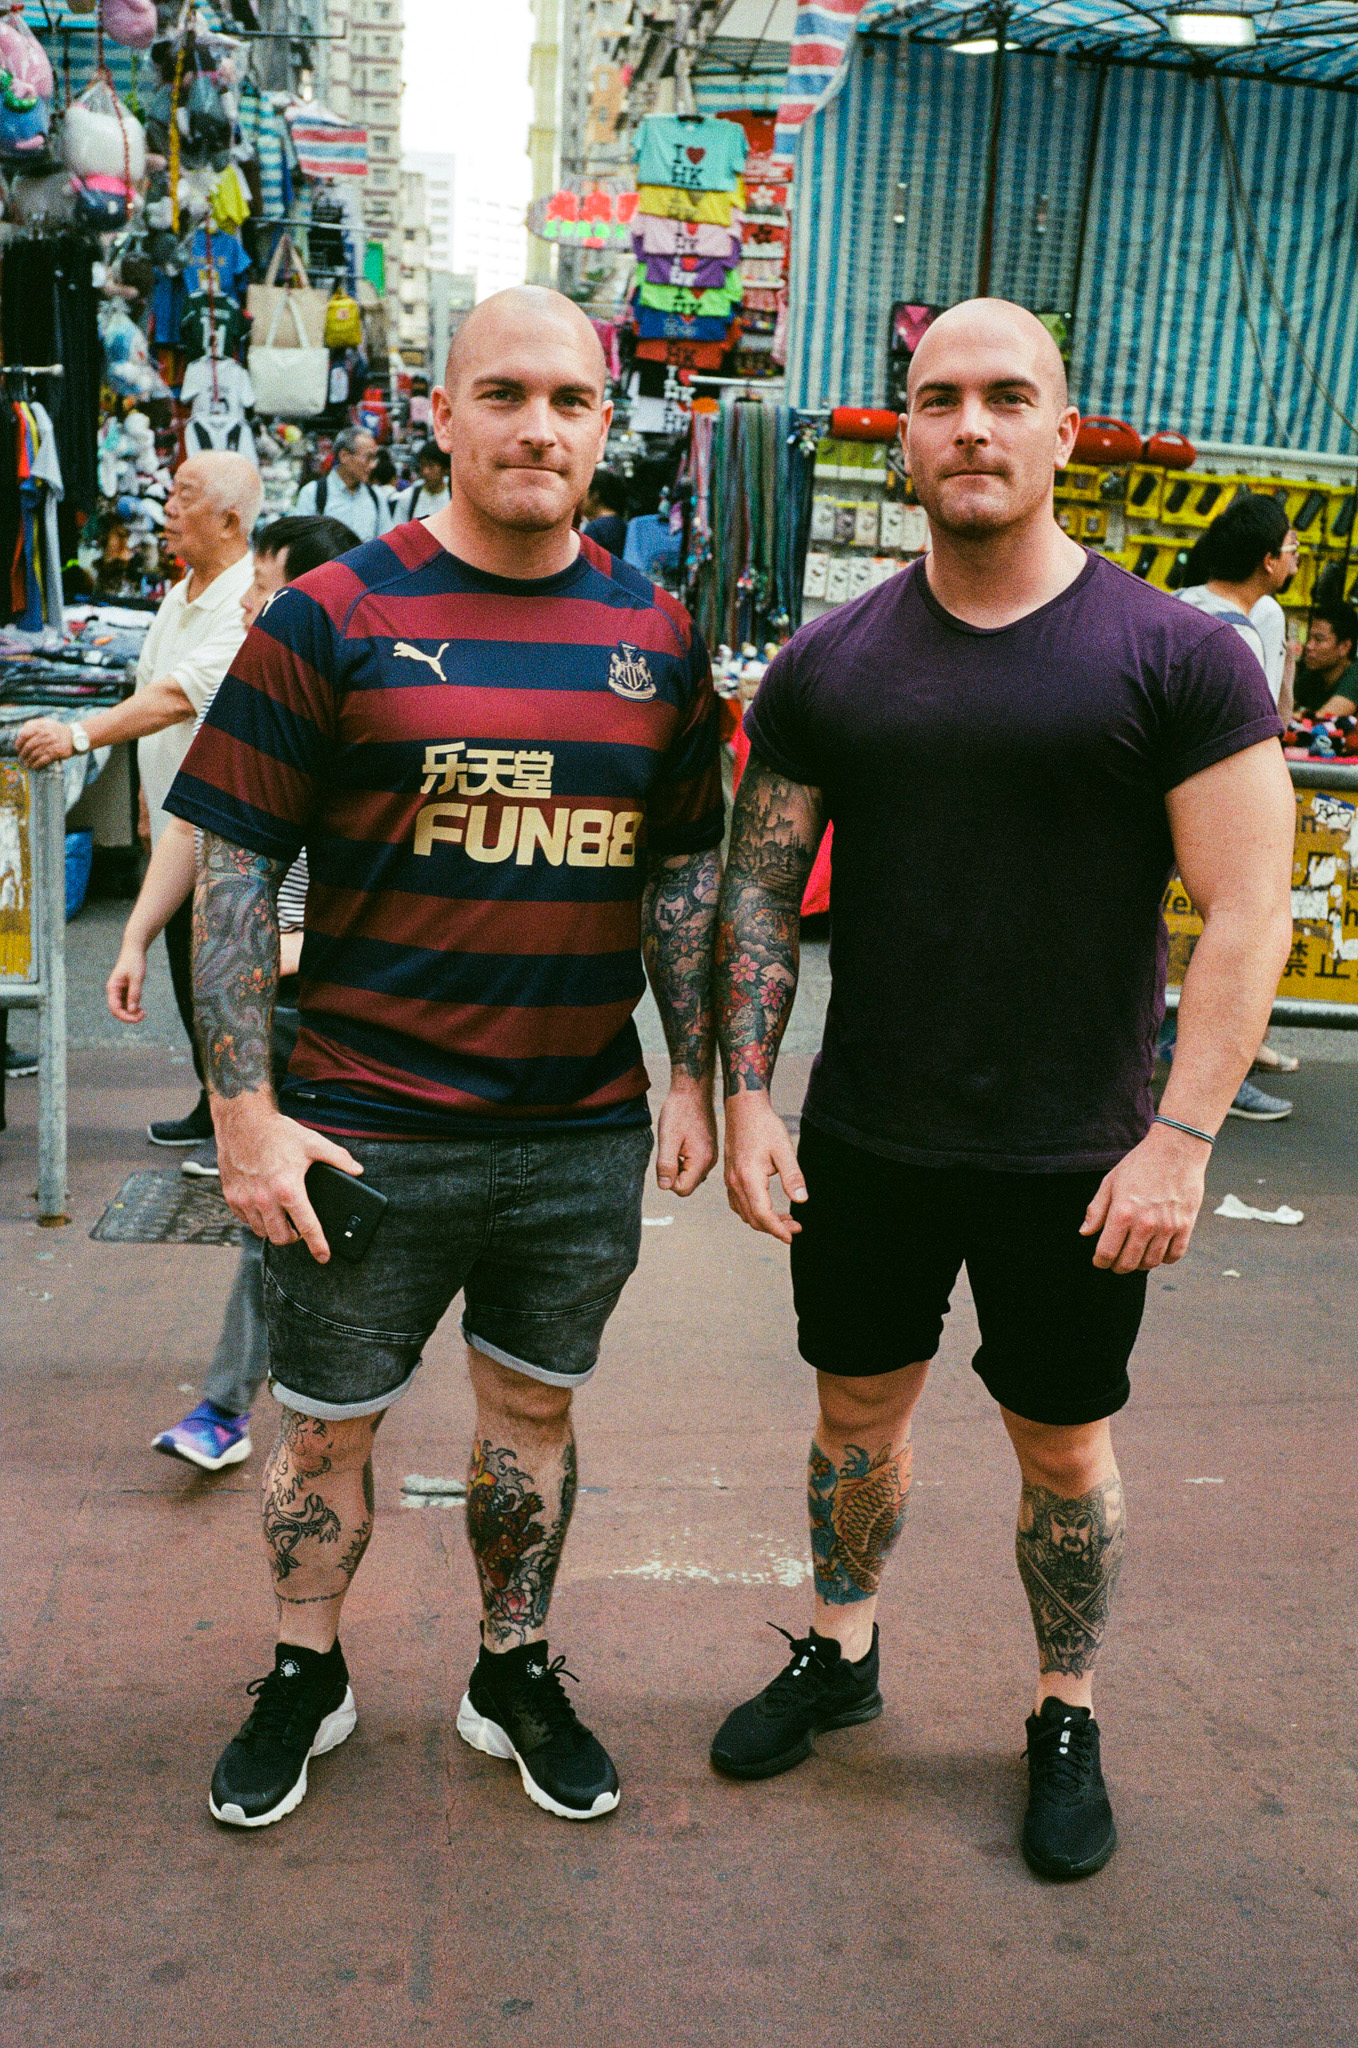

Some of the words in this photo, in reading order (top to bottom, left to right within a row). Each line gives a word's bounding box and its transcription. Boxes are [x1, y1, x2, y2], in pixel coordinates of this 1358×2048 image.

[674, 144, 683, 163] I
[672, 165, 702, 186] HK
[419, 741, 554, 799] 乐天堂
[413, 802, 643, 867] FUN88
